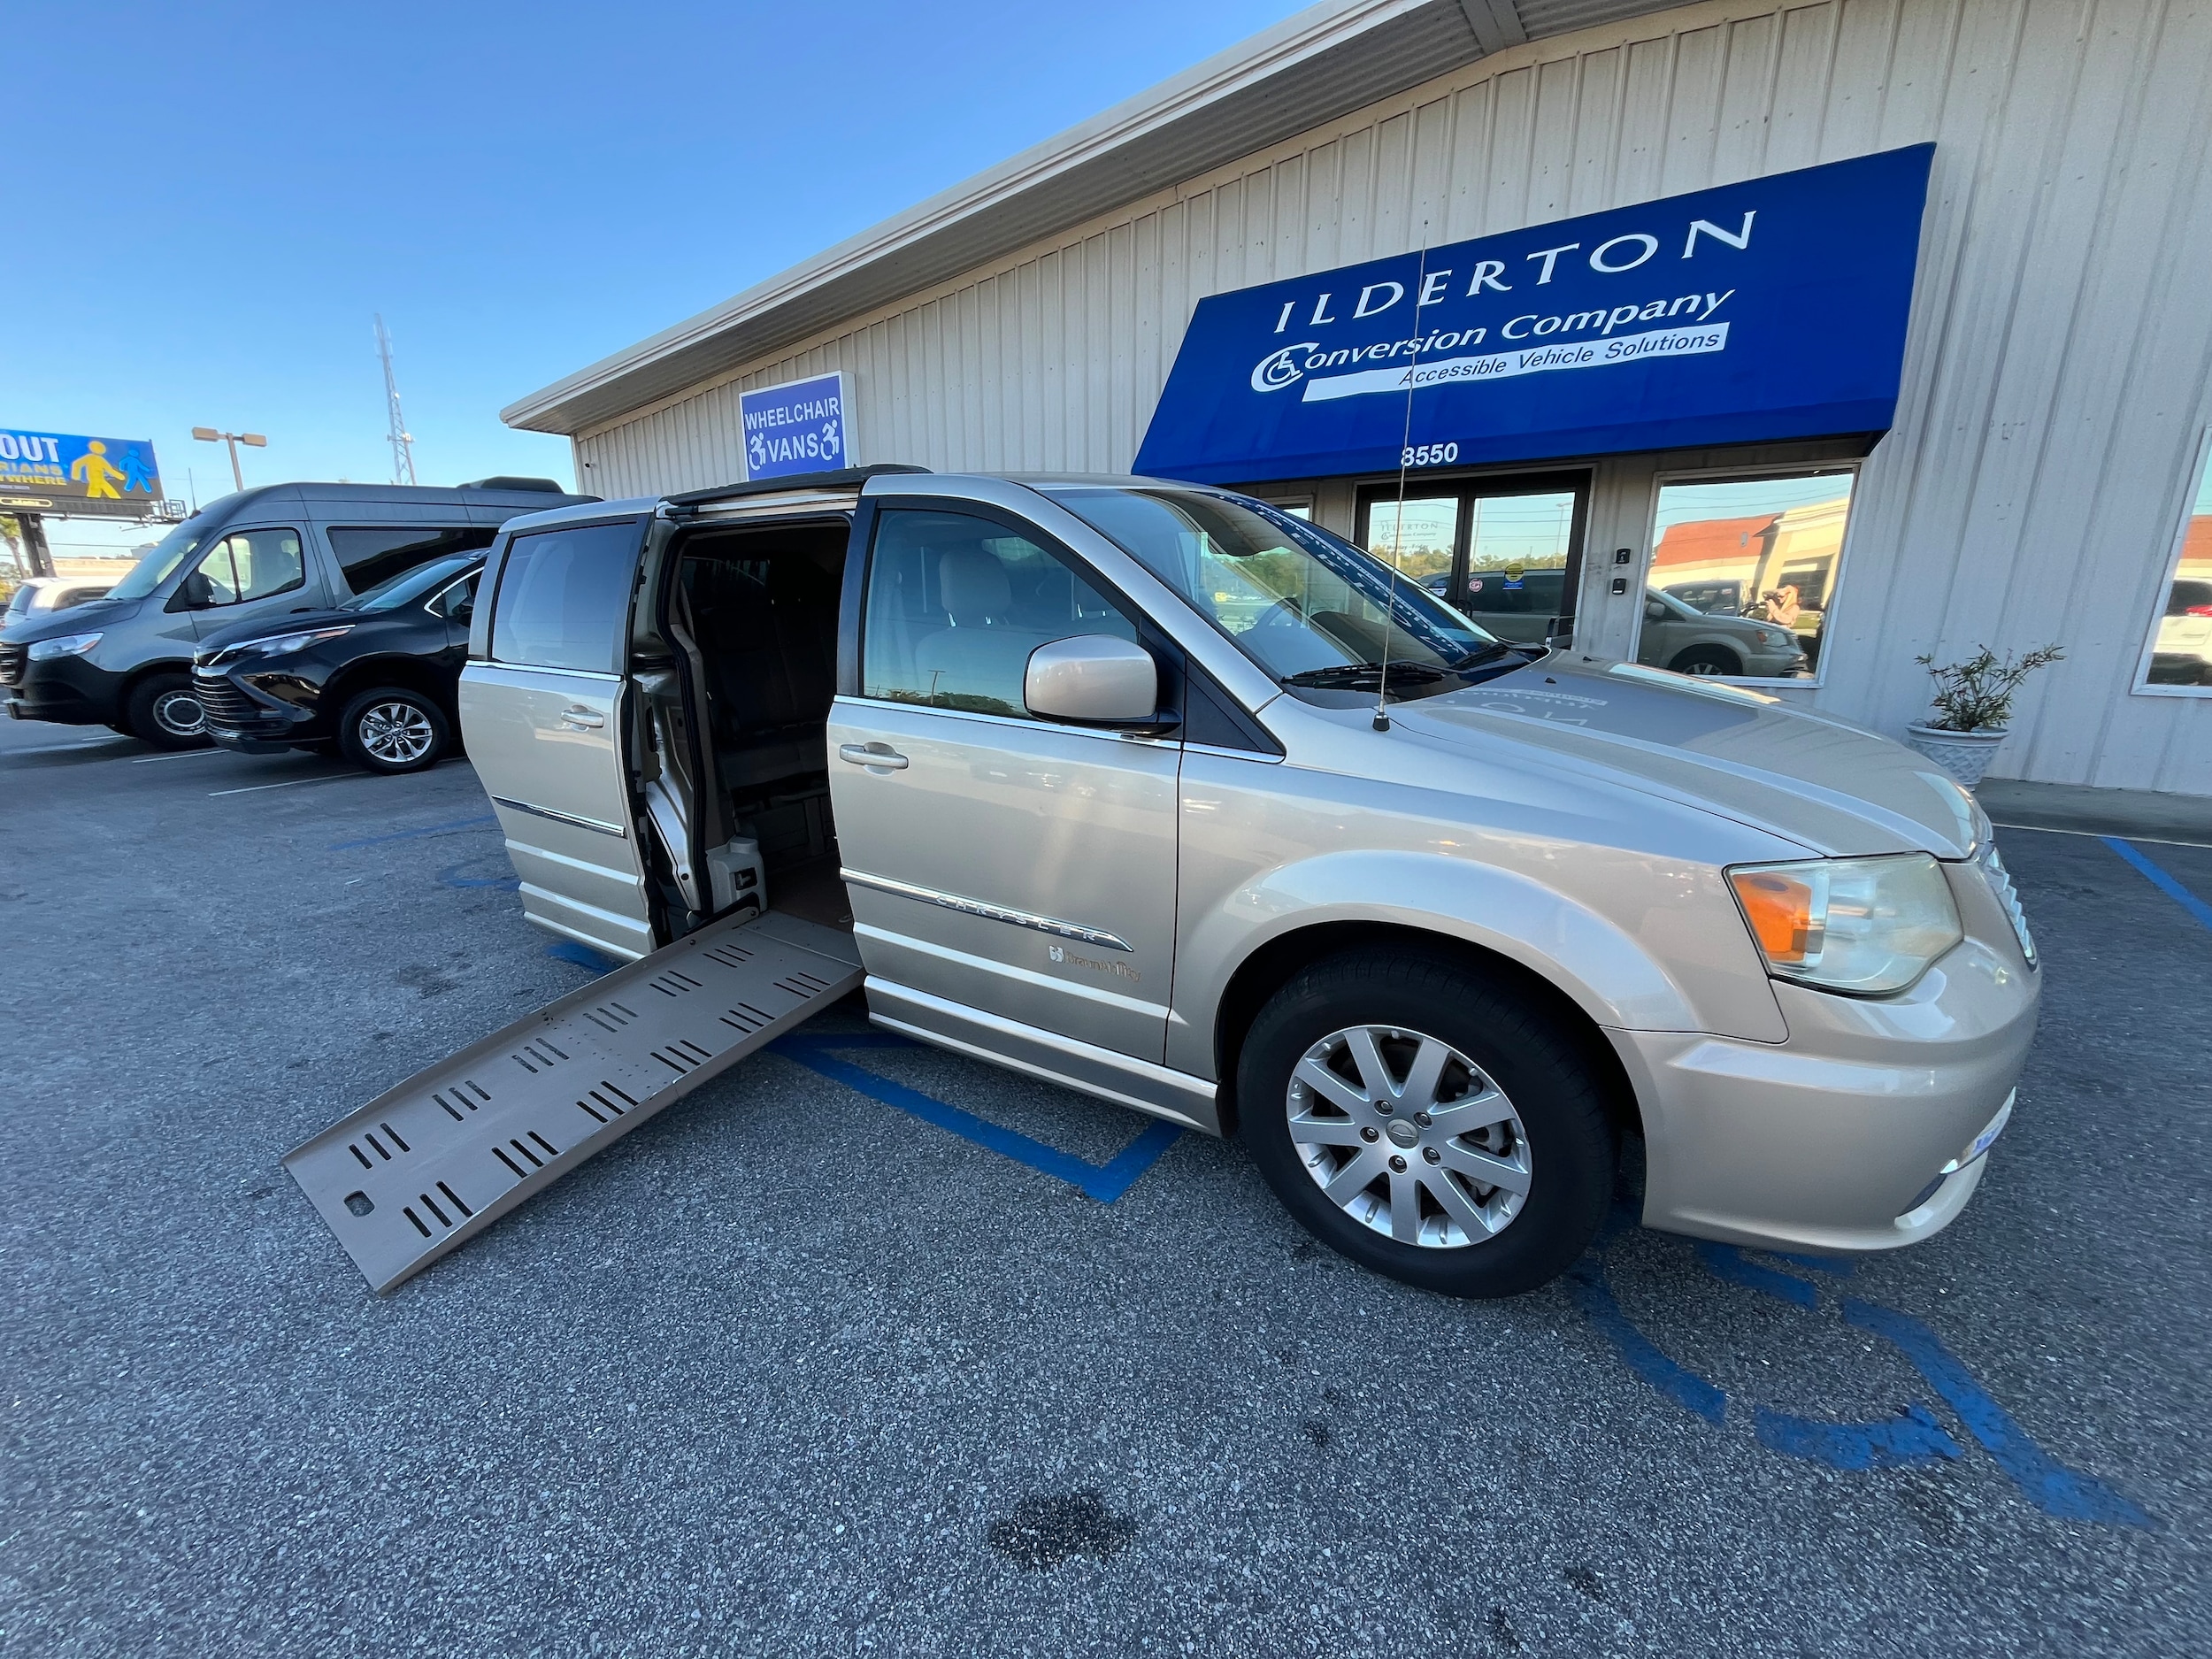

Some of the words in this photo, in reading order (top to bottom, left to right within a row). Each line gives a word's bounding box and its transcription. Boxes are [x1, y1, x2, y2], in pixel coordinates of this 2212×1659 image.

[1274, 211, 1757, 334] ILDERTON
[1250, 328, 1487, 393] Conversion
[1502, 288, 1737, 340] Company
[1399, 357, 1508, 386] Accessible
[1519, 346, 1594, 370] Vehicle
[1604, 332, 1720, 360] Solutions
[744, 396, 840, 431] WHEELCHAIR
[0, 433, 60, 463] OUT
[766, 432, 819, 463] VANS
[1401, 442, 1459, 467] 8550
[935, 896, 1095, 941] CHRYSLER
